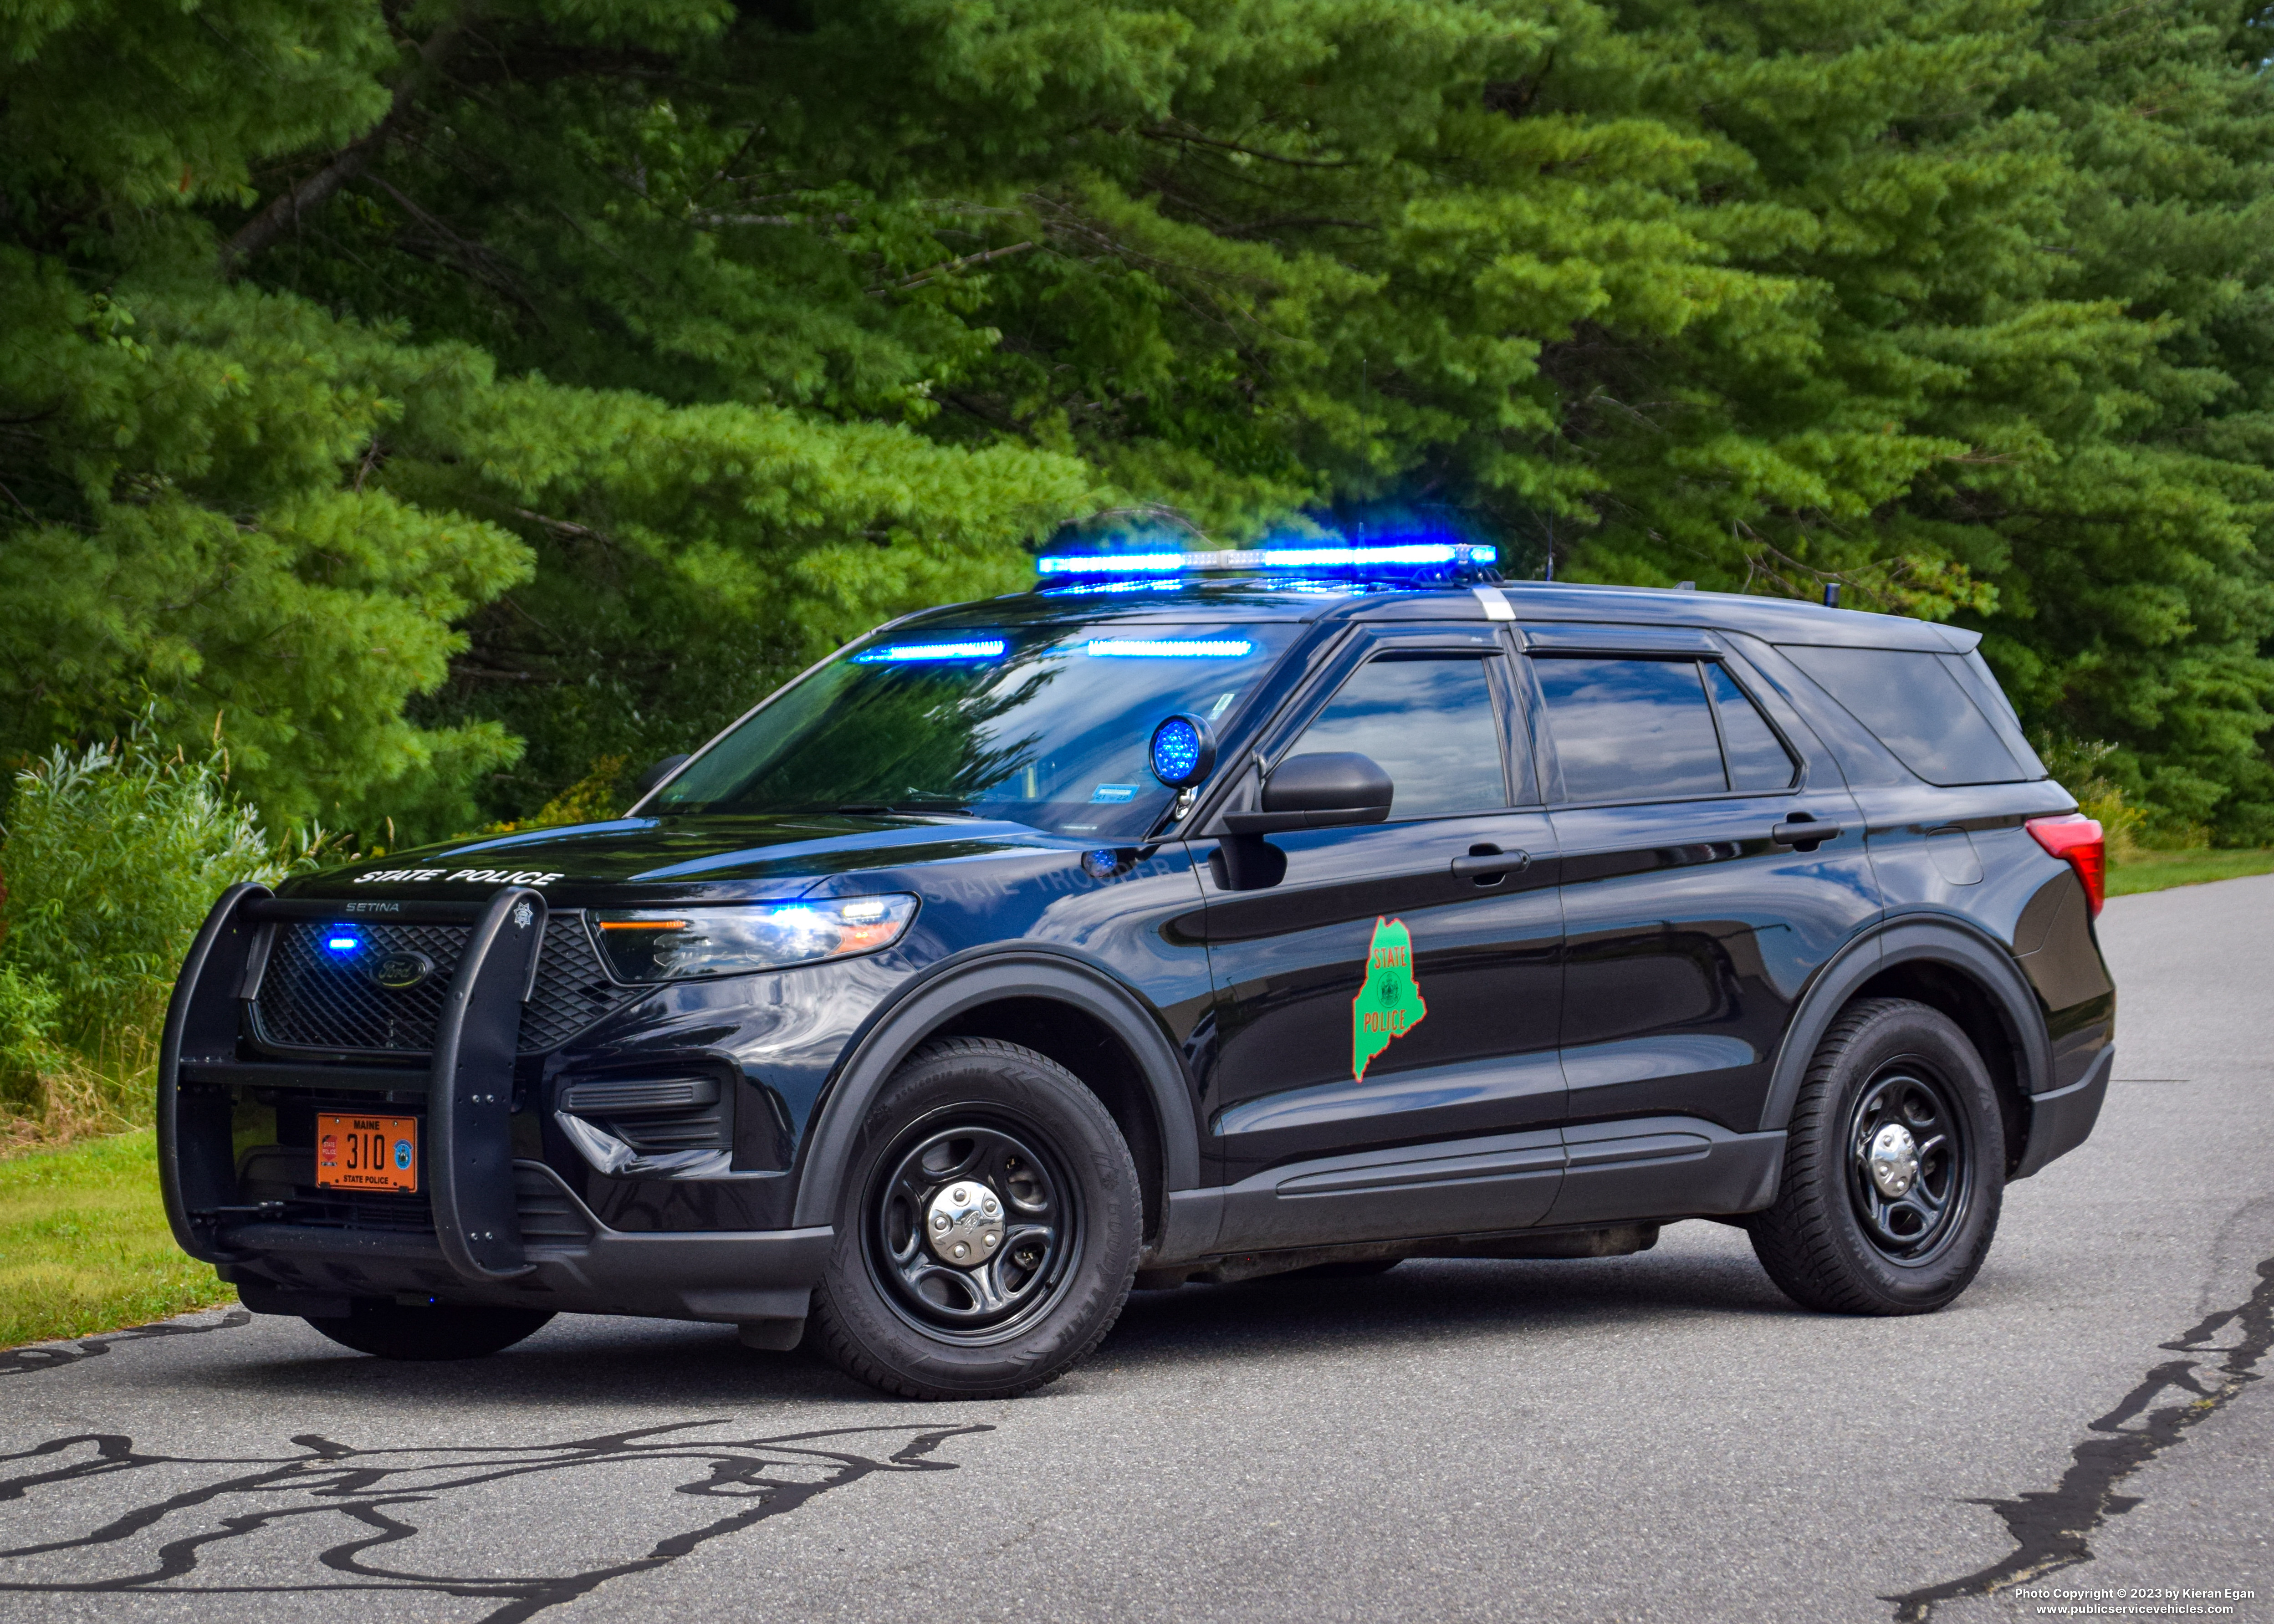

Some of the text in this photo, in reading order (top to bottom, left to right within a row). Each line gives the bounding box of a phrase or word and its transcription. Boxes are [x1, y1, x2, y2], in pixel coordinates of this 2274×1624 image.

[353, 869, 565, 886] STATE POLICE
[920, 858, 1176, 904] STATE TROOPER
[346, 902, 399, 912] SETINA
[1374, 946, 1407, 969] STATE
[378, 960, 413, 979] Ford
[1364, 1009, 1406, 1033] POLICE
[353, 1120, 380, 1130] MAINE
[347, 1133, 385, 1170] 310
[343, 1175, 388, 1184] STATE POLICE
